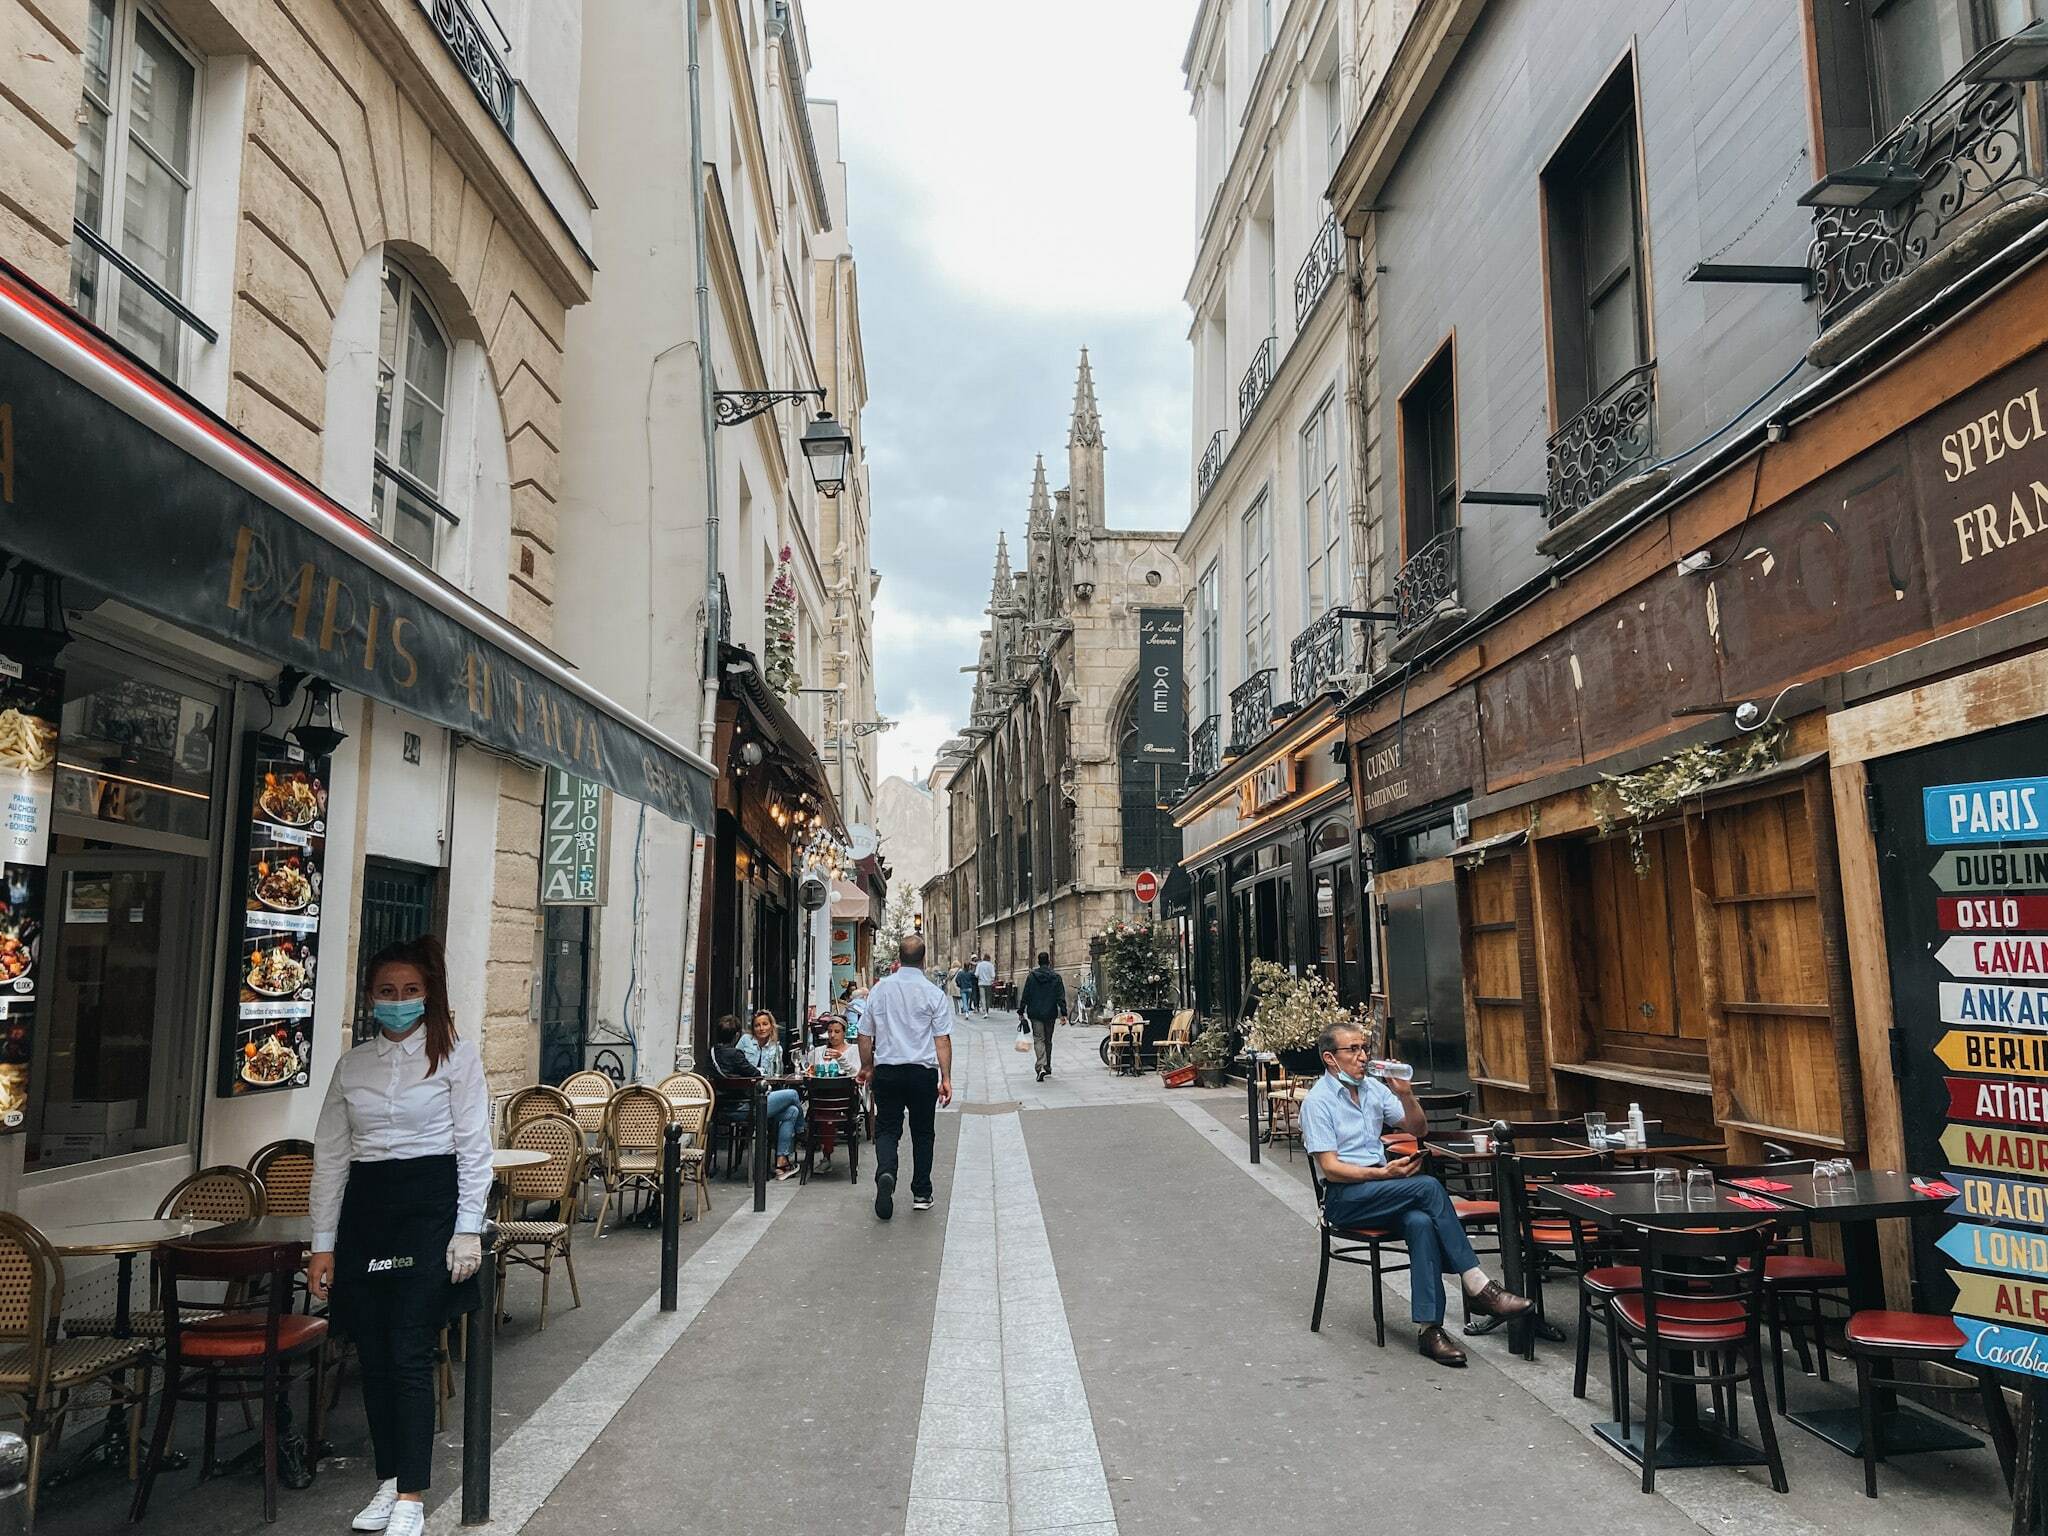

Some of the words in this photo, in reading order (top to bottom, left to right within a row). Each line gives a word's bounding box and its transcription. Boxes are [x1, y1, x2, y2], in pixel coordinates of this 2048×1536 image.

[1942, 387, 2047, 482] SPECI
[1953, 481, 2048, 564] FRAN
[227, 525, 418, 688] PARIS
[1158, 621, 1182, 632] Saint
[1153, 666, 1170, 712] CAFE
[1366, 743, 1401, 781] CUISINE
[1949, 788, 2039, 833] PARIS
[1956, 852, 2048, 886] DUBLIN
[1956, 900, 2019, 928] OSLO
[1960, 986, 2048, 1026] ANKAR
[1965, 1131, 2048, 1172] MADR
[1964, 1179, 2048, 1224] CRACO
[1973, 1229, 2048, 1273] LOND
[1995, 1284, 2048, 1325] ALG
